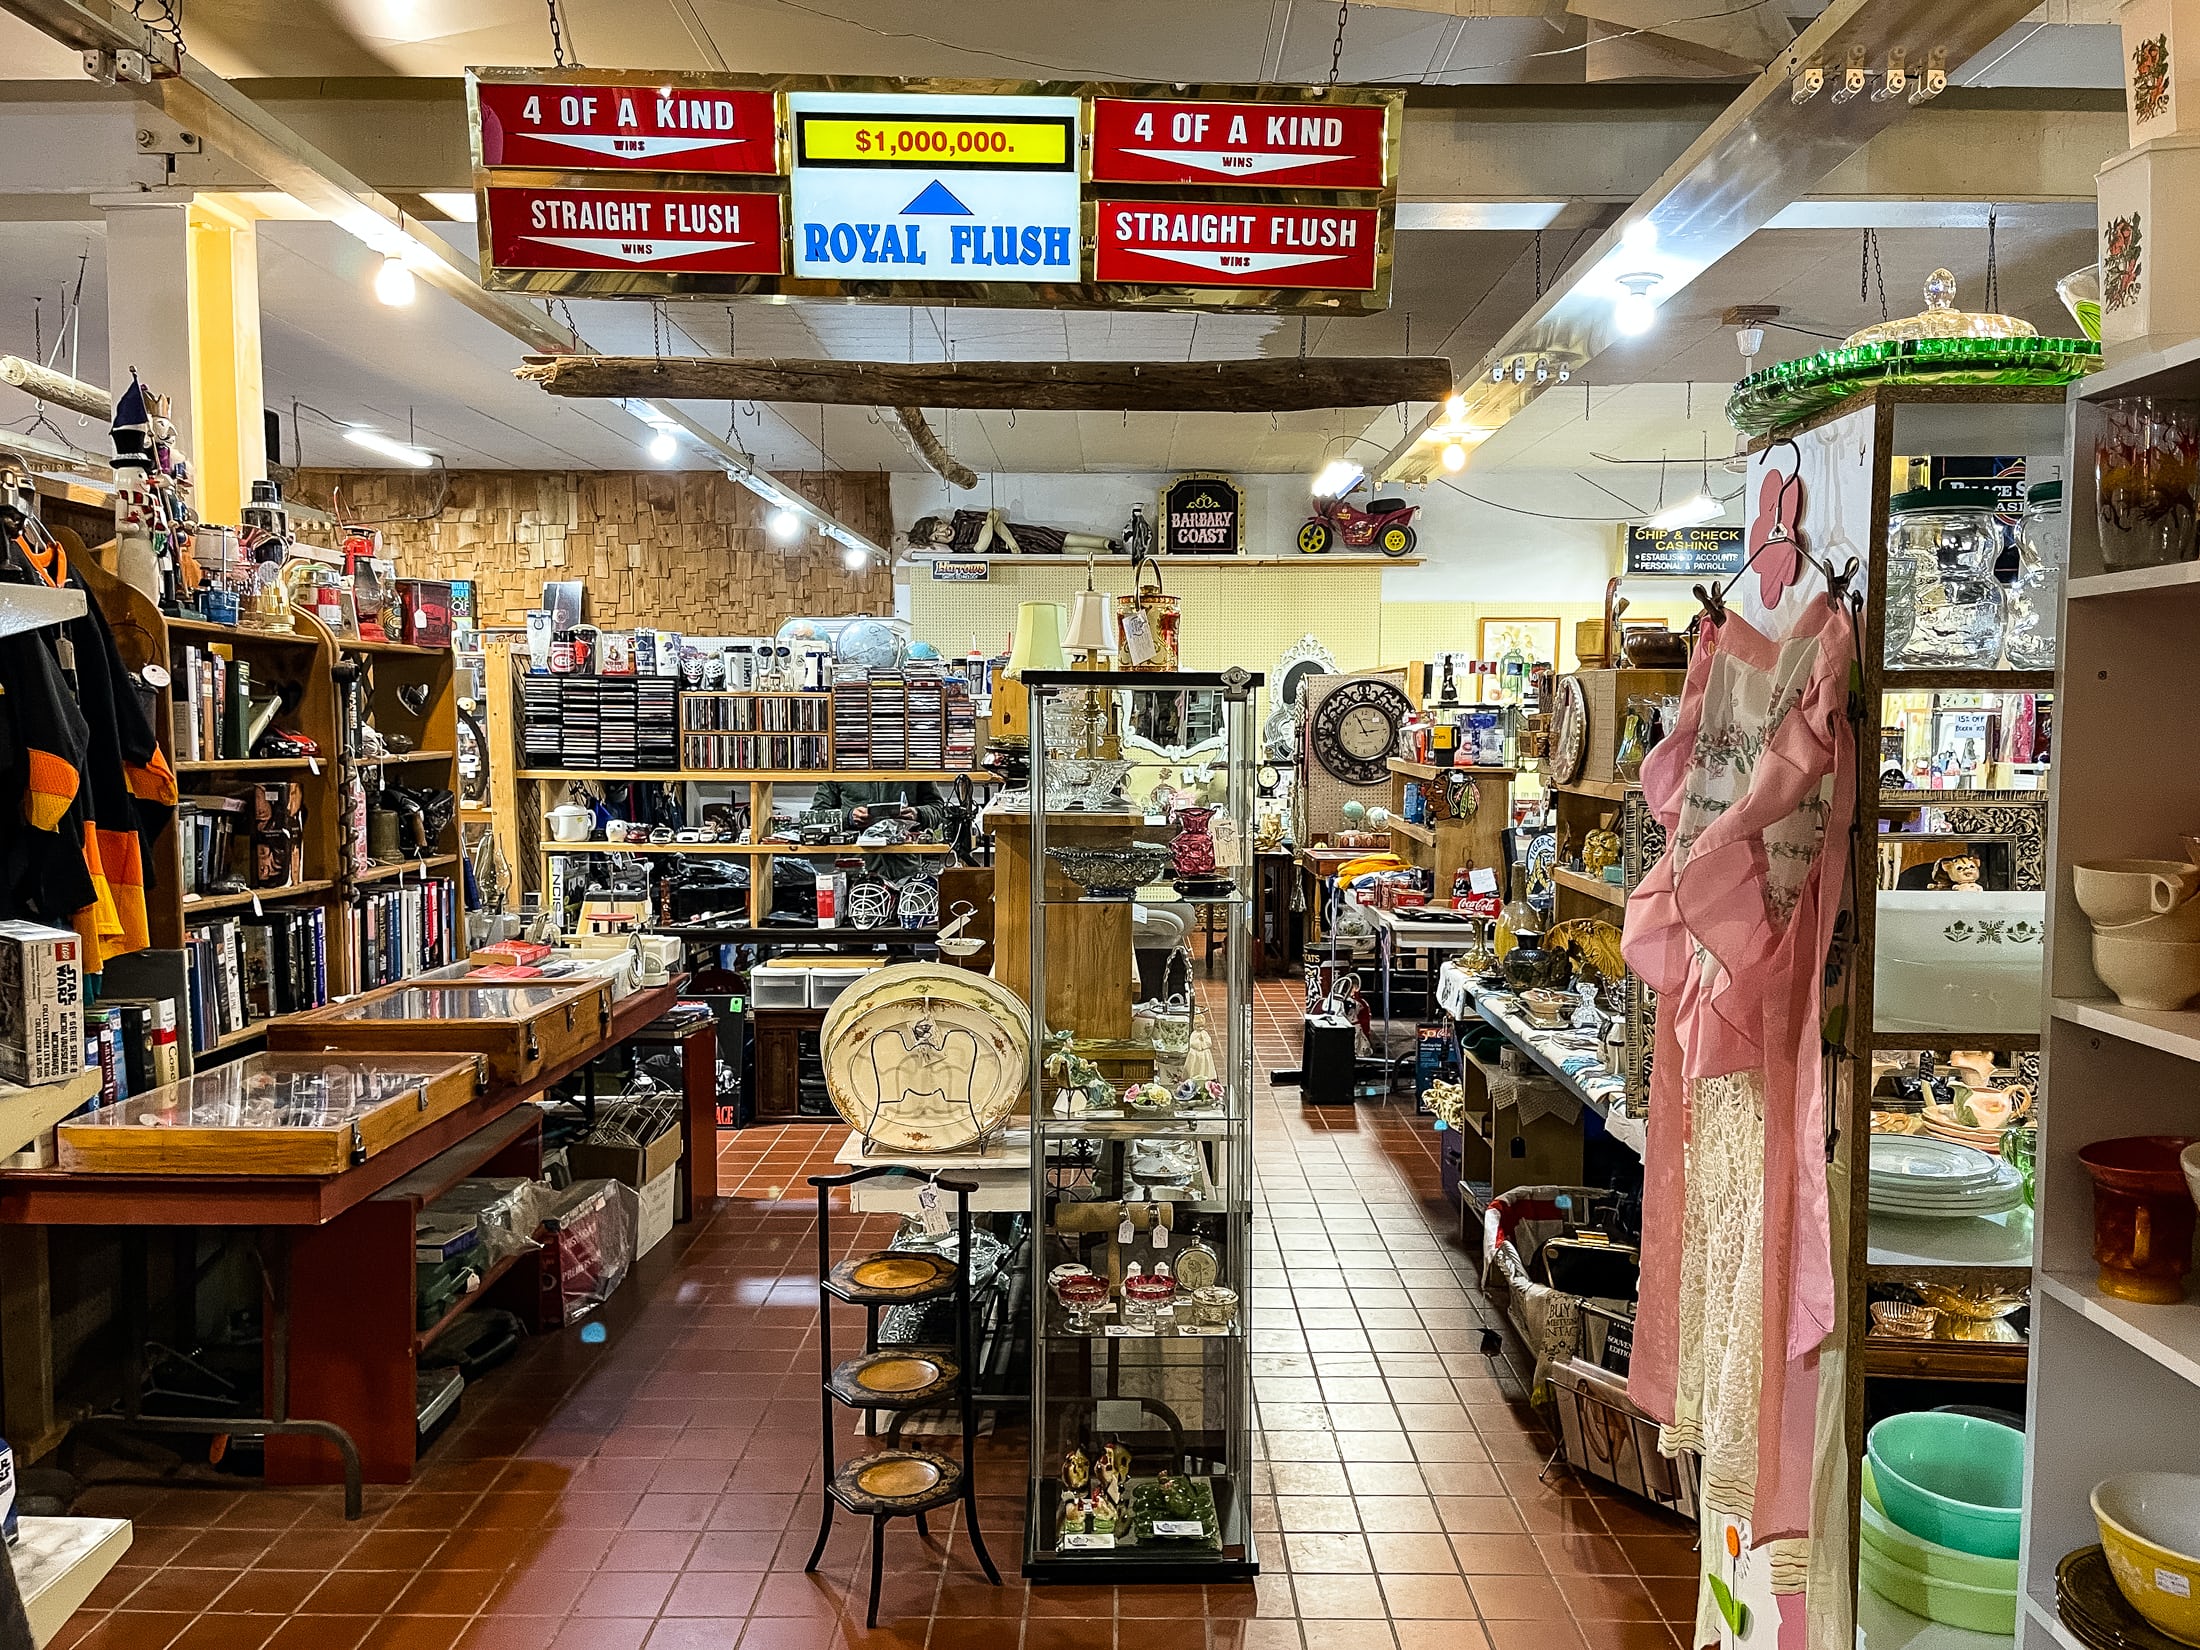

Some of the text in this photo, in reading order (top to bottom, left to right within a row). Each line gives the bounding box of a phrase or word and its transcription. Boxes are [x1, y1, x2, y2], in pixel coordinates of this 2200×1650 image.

[522, 95, 735, 131] 4 OF A KIND
[1133, 112, 1344, 148] 4 OF A KIND
[612, 140, 647, 152] WINS
[855, 129, 1015, 157] $1,000,000.
[1221, 156, 1254, 169] WINS
[530, 199, 741, 235] STRAIGHT FLUSH
[1115, 211, 1358, 248] STRAIGHT FLUSH
[620, 243, 654, 256] WINS
[803, 222, 1072, 267] ROYAL FLUSH
[1219, 255, 1251, 268] WINS
[1171, 511, 1235, 528] BARBARY
[1177, 528, 1228, 544] COAST
[1635, 530, 1741, 541] CHIP & CHECK
[1655, 541, 1719, 551] CASHING
[1640, 553, 1740, 562] ESTABLISD ACCOUNTS
[935, 560, 987, 576] Harrows
[1640, 562, 1682, 571] PERSONAL
[1693, 562, 1728, 571] PAYROLL
[552, 874, 561, 912] NCIS
[56, 964, 68, 1006] WARS
[66, 963, 77, 1005] STAR
[1549, 1303, 1571, 1318] BUY
